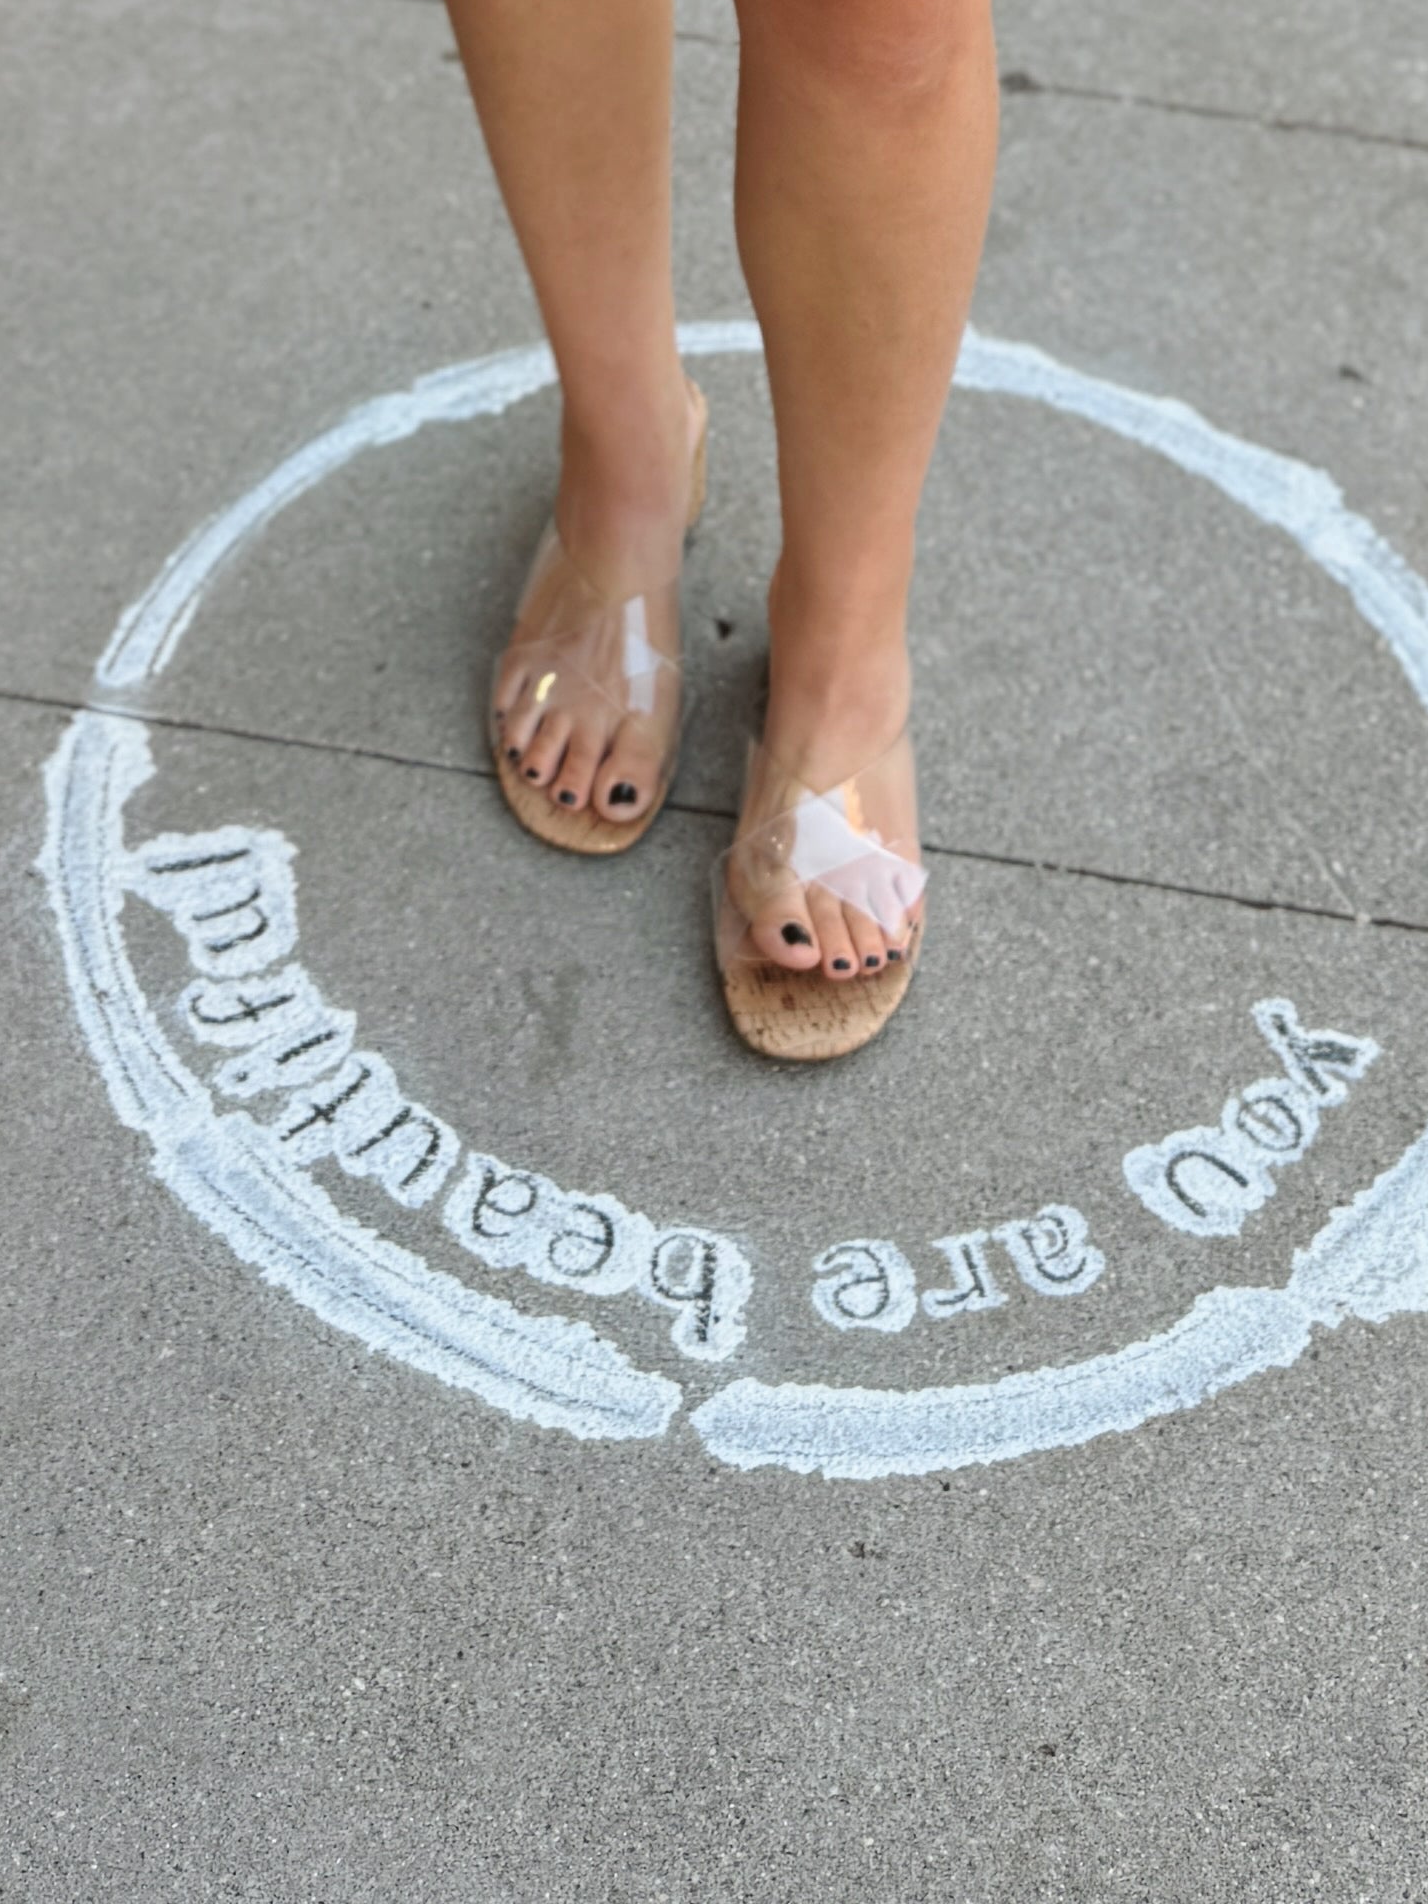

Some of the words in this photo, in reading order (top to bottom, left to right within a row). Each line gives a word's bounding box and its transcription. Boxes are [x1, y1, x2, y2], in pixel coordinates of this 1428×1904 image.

[132, 828, 752, 1358] beautiful
[1128, 1000, 1378, 1235] you
[812, 1204, 1104, 1331] are
